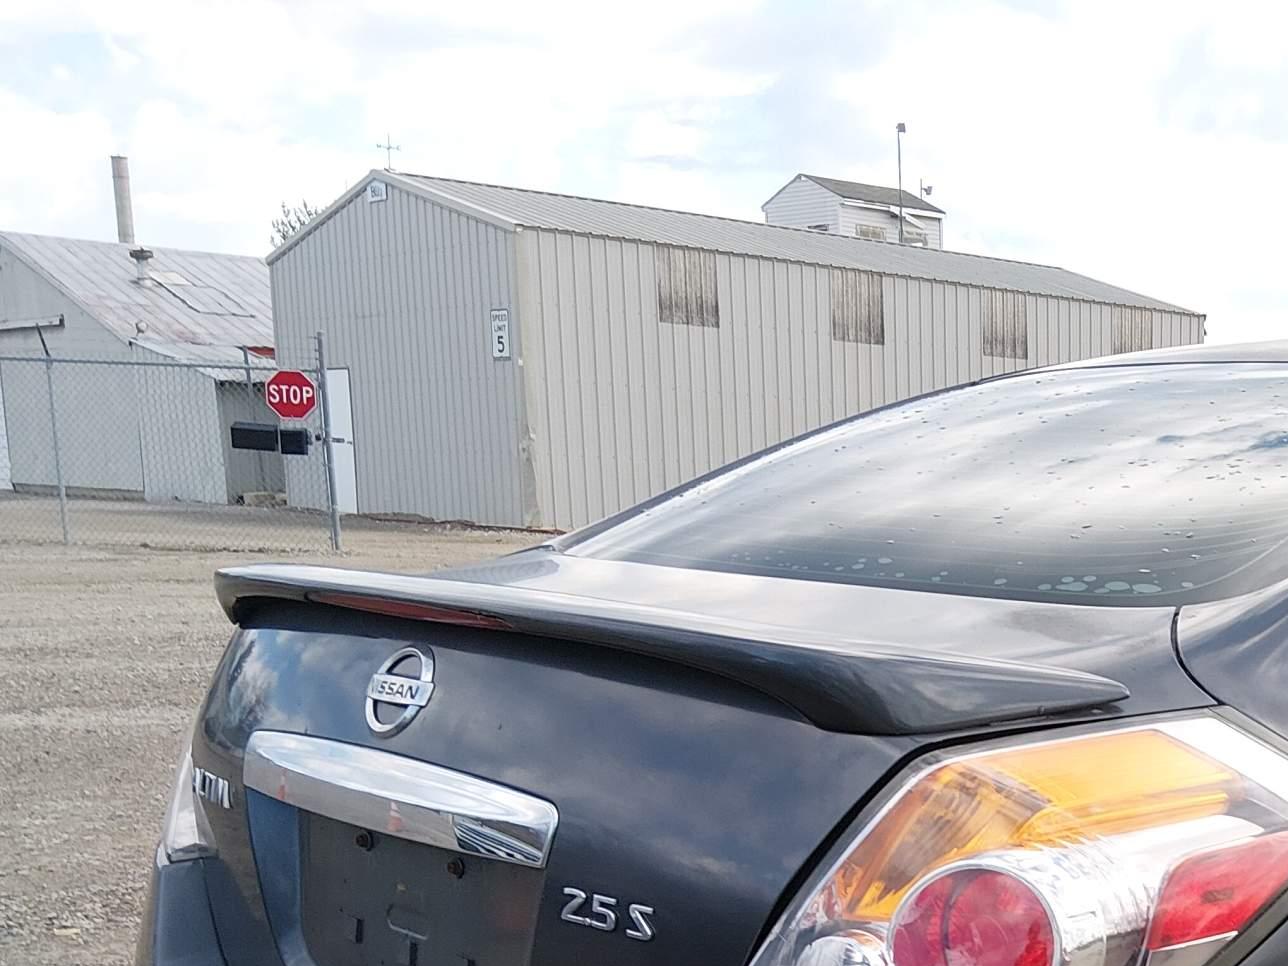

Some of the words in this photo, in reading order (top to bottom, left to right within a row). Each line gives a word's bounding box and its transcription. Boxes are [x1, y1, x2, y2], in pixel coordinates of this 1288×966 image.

[497, 335, 505, 353] 5
[269, 384, 313, 405] STOP
[371, 680, 420, 700] SSAN
[625, 903, 654, 941] S
